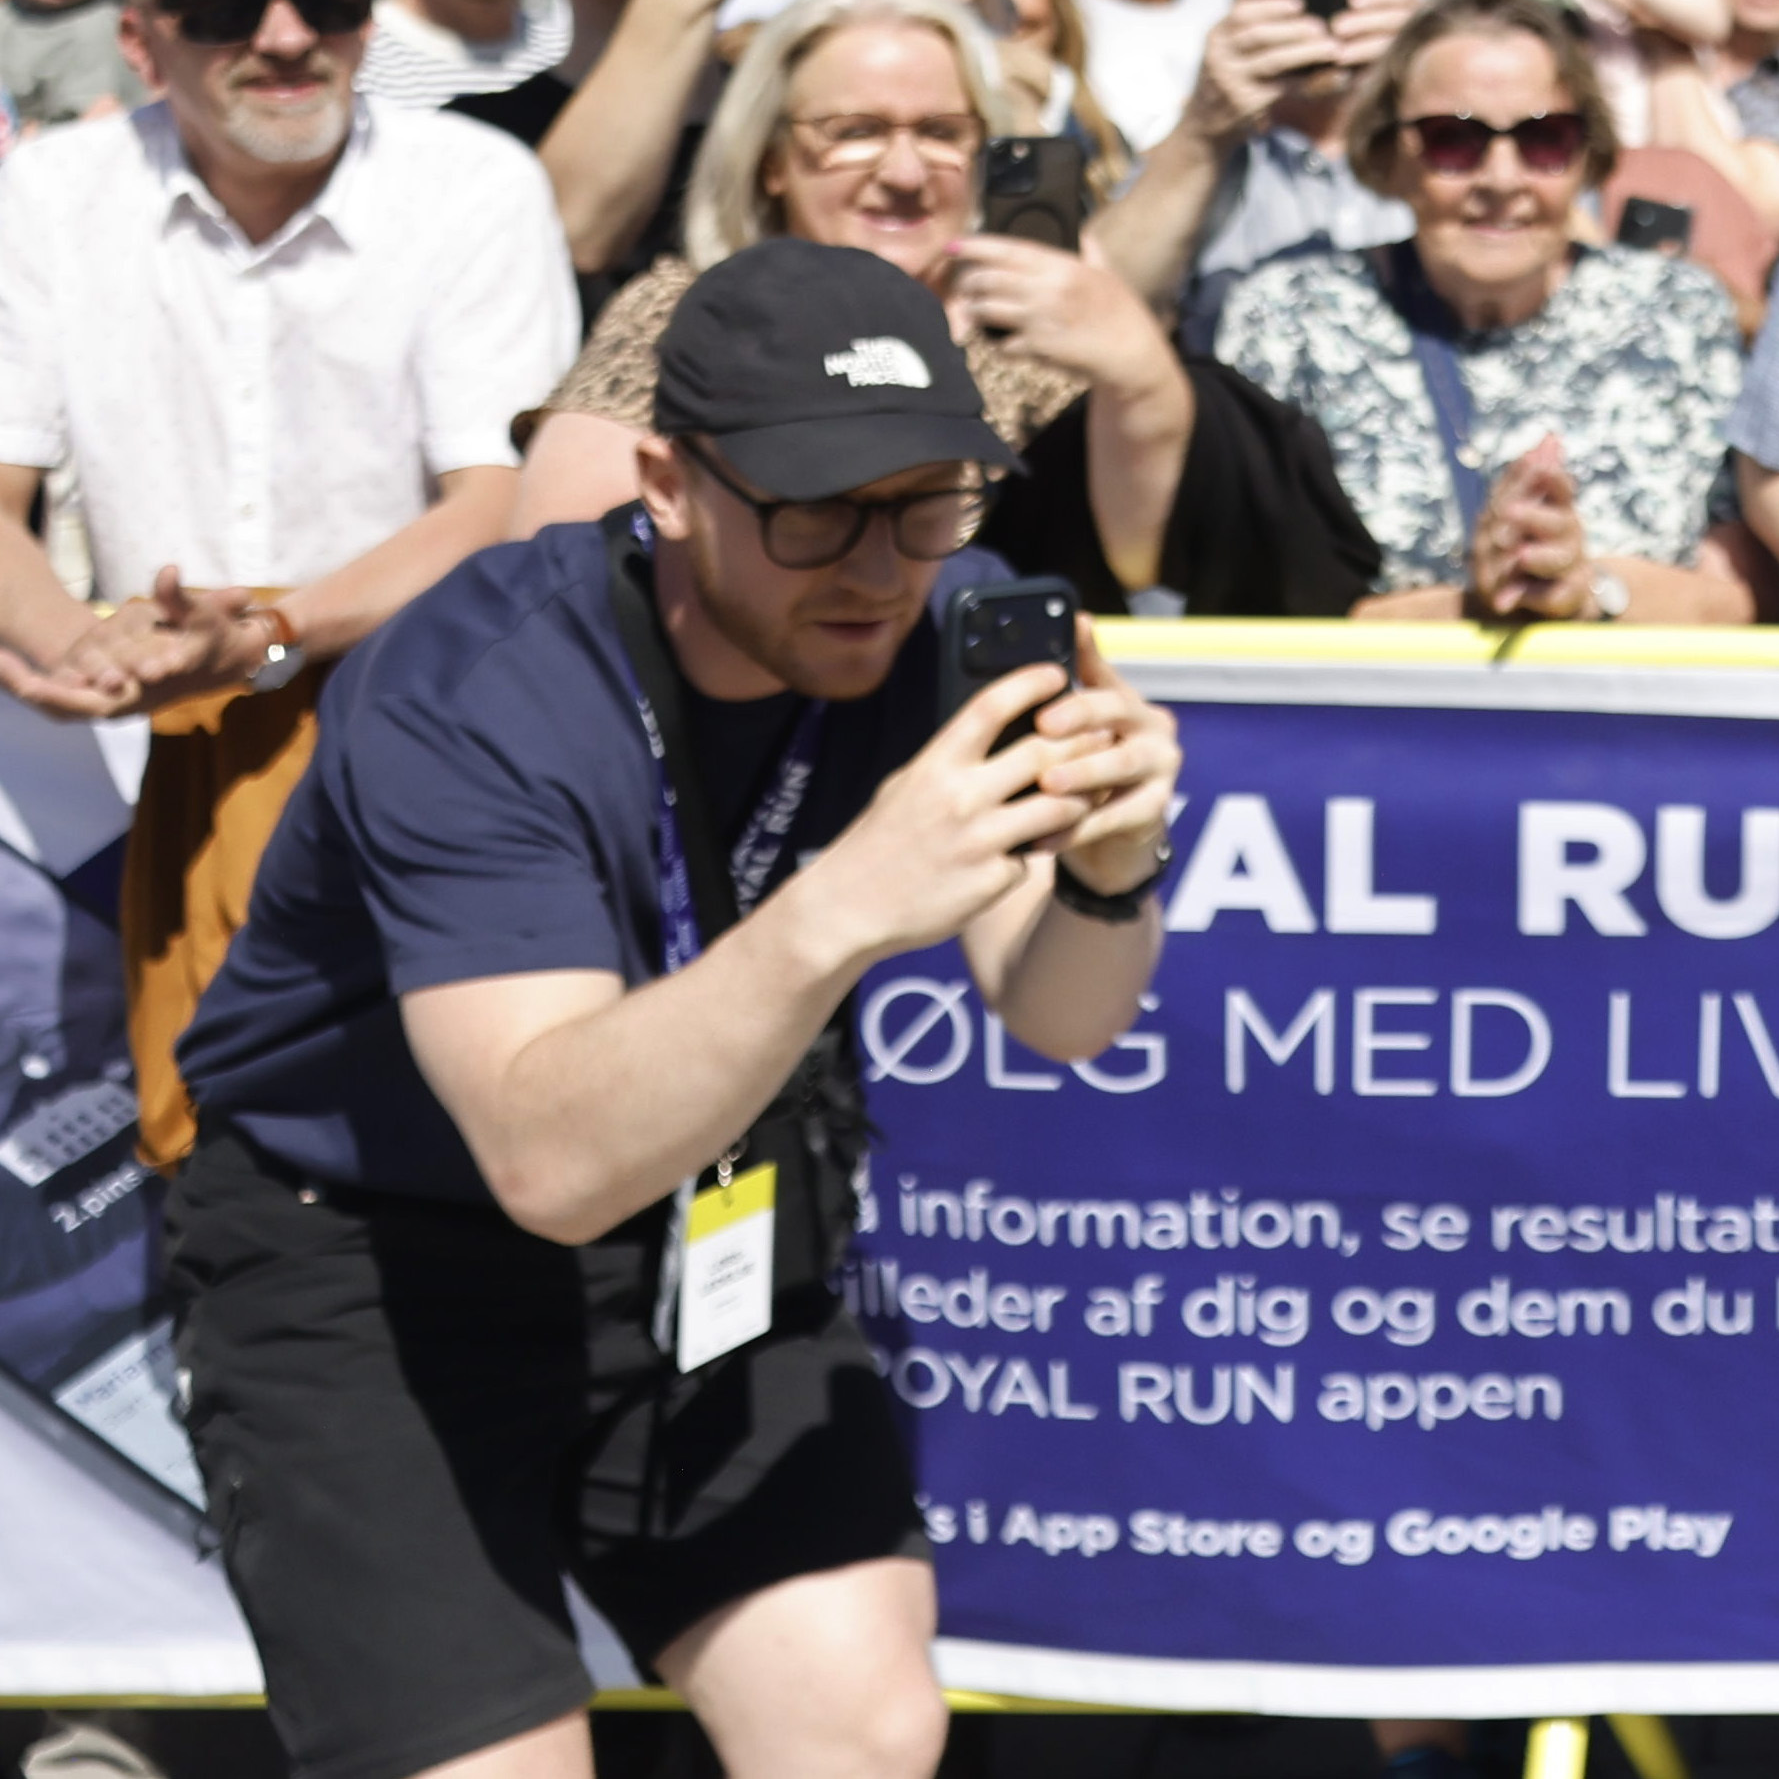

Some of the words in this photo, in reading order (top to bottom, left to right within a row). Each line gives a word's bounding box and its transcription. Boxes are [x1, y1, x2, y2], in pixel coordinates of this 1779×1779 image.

[860, 975, 1169, 1095] ØLG
[1225, 986, 1553, 1098] MED
[899, 1175, 1361, 1257] information,
[1381, 1202, 1470, 1253] se
[839, 1257, 1067, 1334] illeder
[1083, 1273, 1164, 1338] af
[1181, 1274, 1311, 1348] dig
[1330, 1286, 1437, 1347] og
[1456, 1276, 1632, 1339] dem
[1651, 1276, 1755, 1338] du
[886, 1346, 1099, 1423] OYAL
[1118, 1361, 1296, 1426] RUN
[1316, 1372, 1564, 1433] appen
[965, 1500, 990, 1545] i
[1001, 1503, 1121, 1558] App
[1129, 1508, 1284, 1559] Store
[1293, 1519, 1376, 1567] og
[1384, 1507, 1599, 1562] Google
[1608, 1504, 1734, 1559] Play
